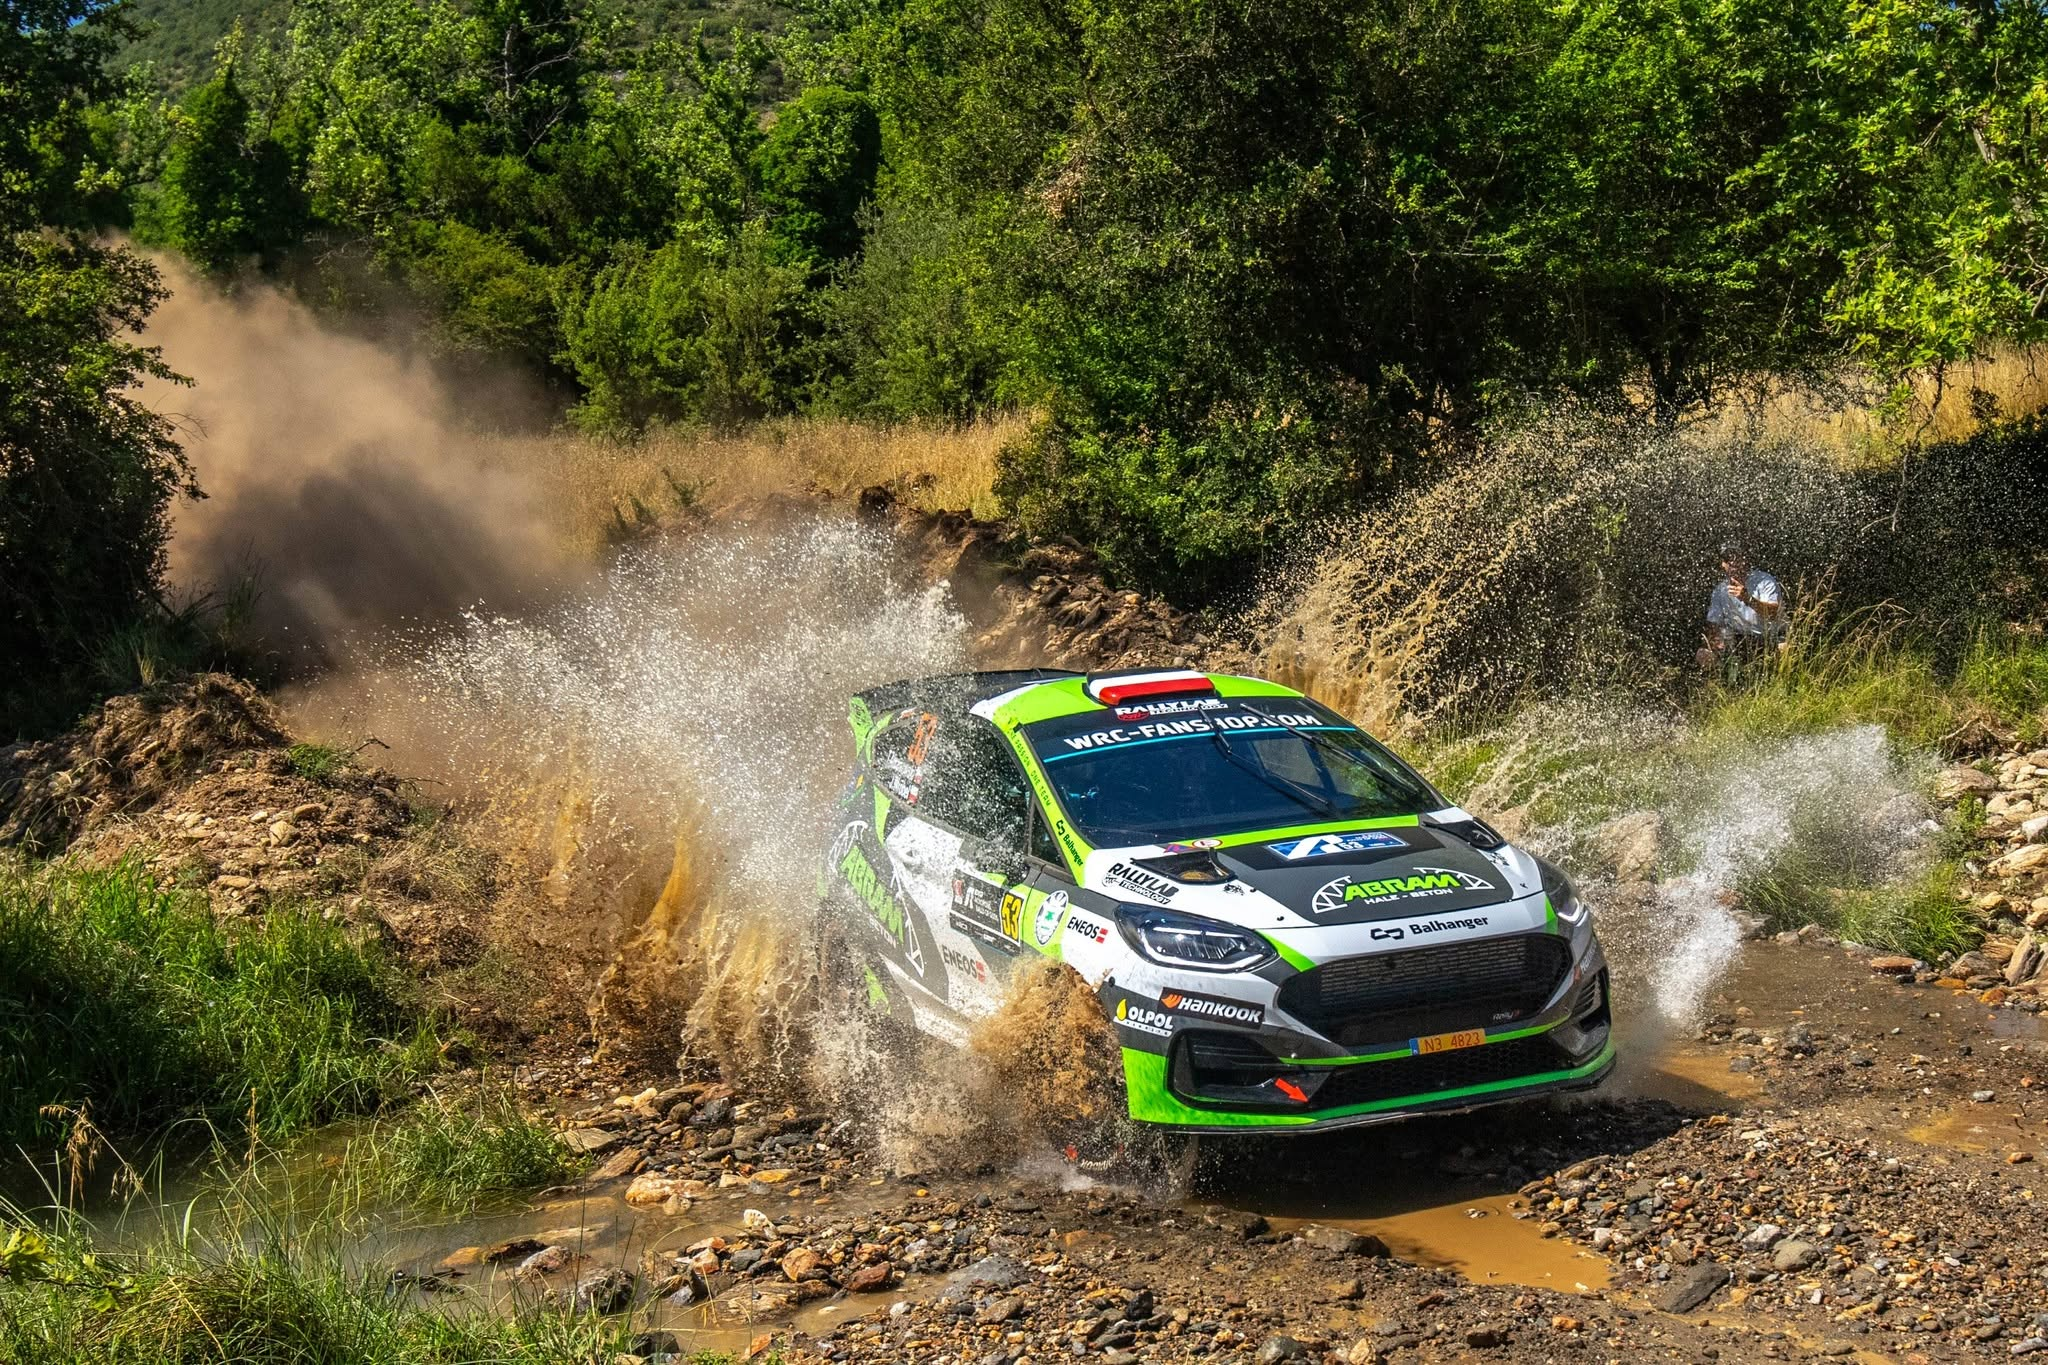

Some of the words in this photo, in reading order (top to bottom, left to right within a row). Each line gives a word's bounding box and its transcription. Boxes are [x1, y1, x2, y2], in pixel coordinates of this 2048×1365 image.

[1064, 714, 1323, 750] WRC-FANSHOP.COM
[1063, 833, 1084, 866] Balhanger
[1107, 862, 1180, 897] RALLYLAB
[1119, 879, 1172, 905] TECHNOLOGY
[1343, 873, 1462, 902] ABRAM
[1364, 892, 1400, 905] HALE
[1410, 888, 1454, 899] BETON
[1001, 893, 1021, 941] 53
[1067, 916, 1100, 939] ENEOS
[1409, 916, 1489, 935] Balhanger
[941, 944, 978, 979] ENEOS
[1128, 1006, 1174, 1030] OLPOL
[1424, 1037, 1443, 1052] N3
[1450, 1031, 1481, 1048] 4823
